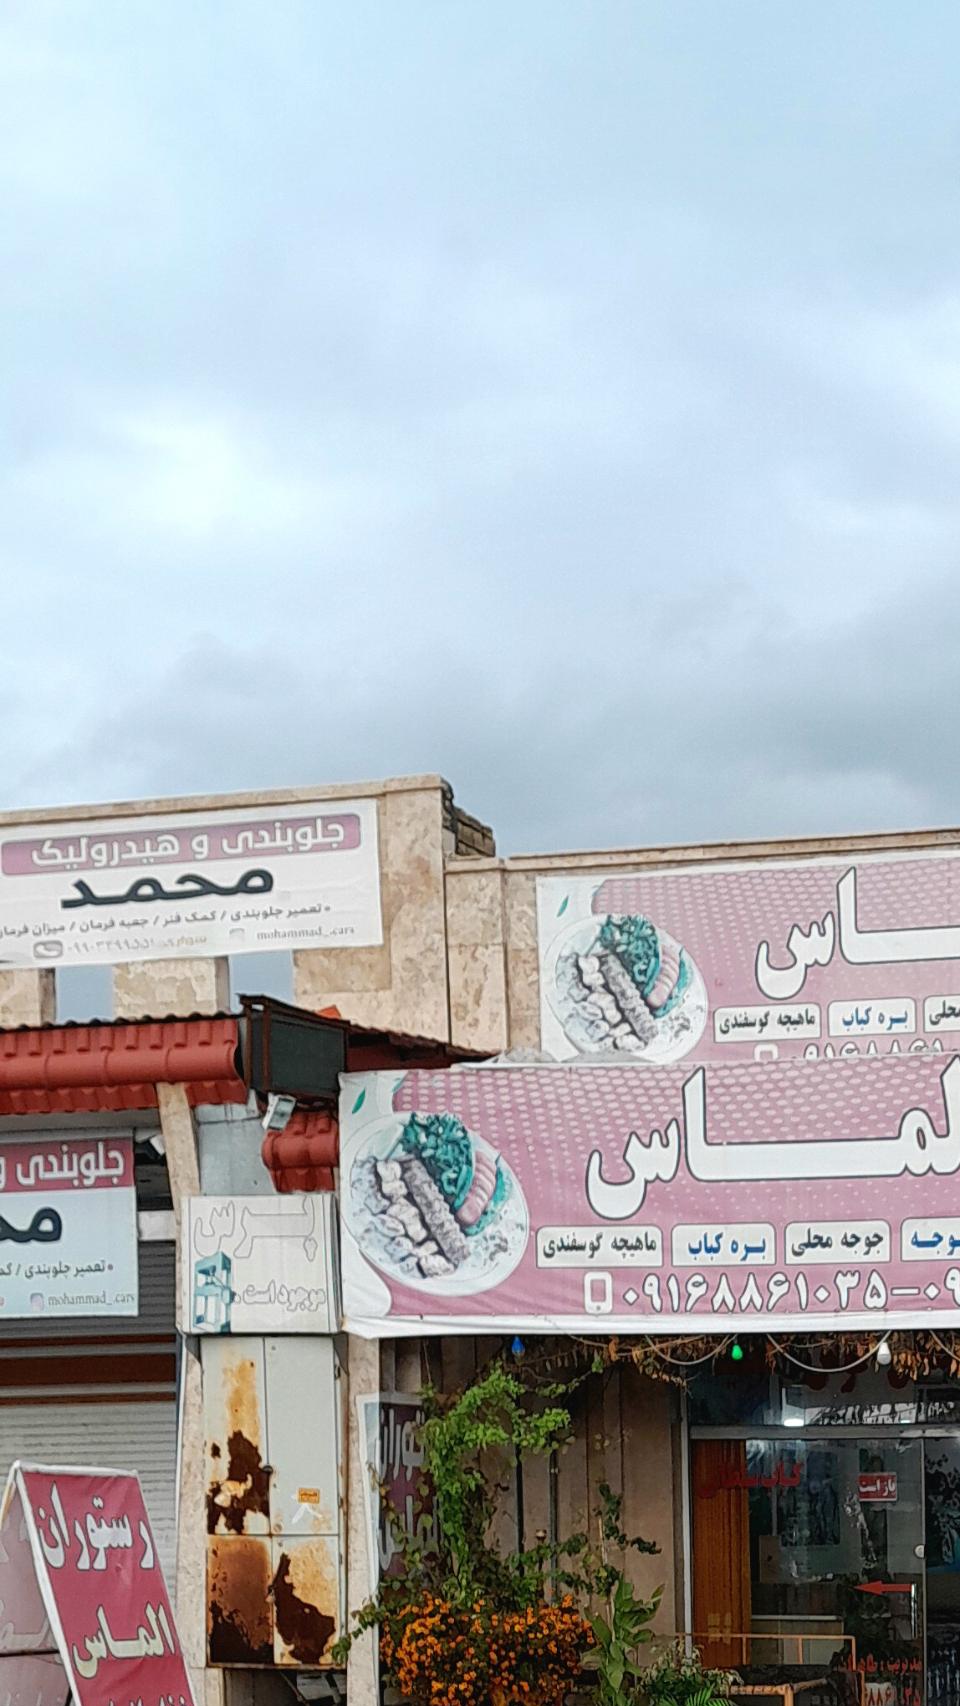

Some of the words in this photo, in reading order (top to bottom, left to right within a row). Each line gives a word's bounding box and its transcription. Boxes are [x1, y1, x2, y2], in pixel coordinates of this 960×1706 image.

[31, 831, 180, 870] هیدرولیک
[191, 833, 209, 860] و
[222, 817, 345, 853] جلوبندی
[60, 868, 274, 909] محمد
[841, 1006, 872, 1031] کباب
[878, 1007, 908, 1031] بره
[17, 1142, 124, 1187] جلوبندی
[543, 1232, 603, 1260] گوسفندی
[610, 1231, 657, 1261] ماهیچه
[687, 1231, 723, 1262] کباب
[730, 1231, 767, 1262] بره
[791, 1227, 833, 1258] محلی
[840, 1231, 884, 1256] جوجه
[37, 1480, 155, 1571] رستوران
[72, 1601, 176, 1678] الماس
